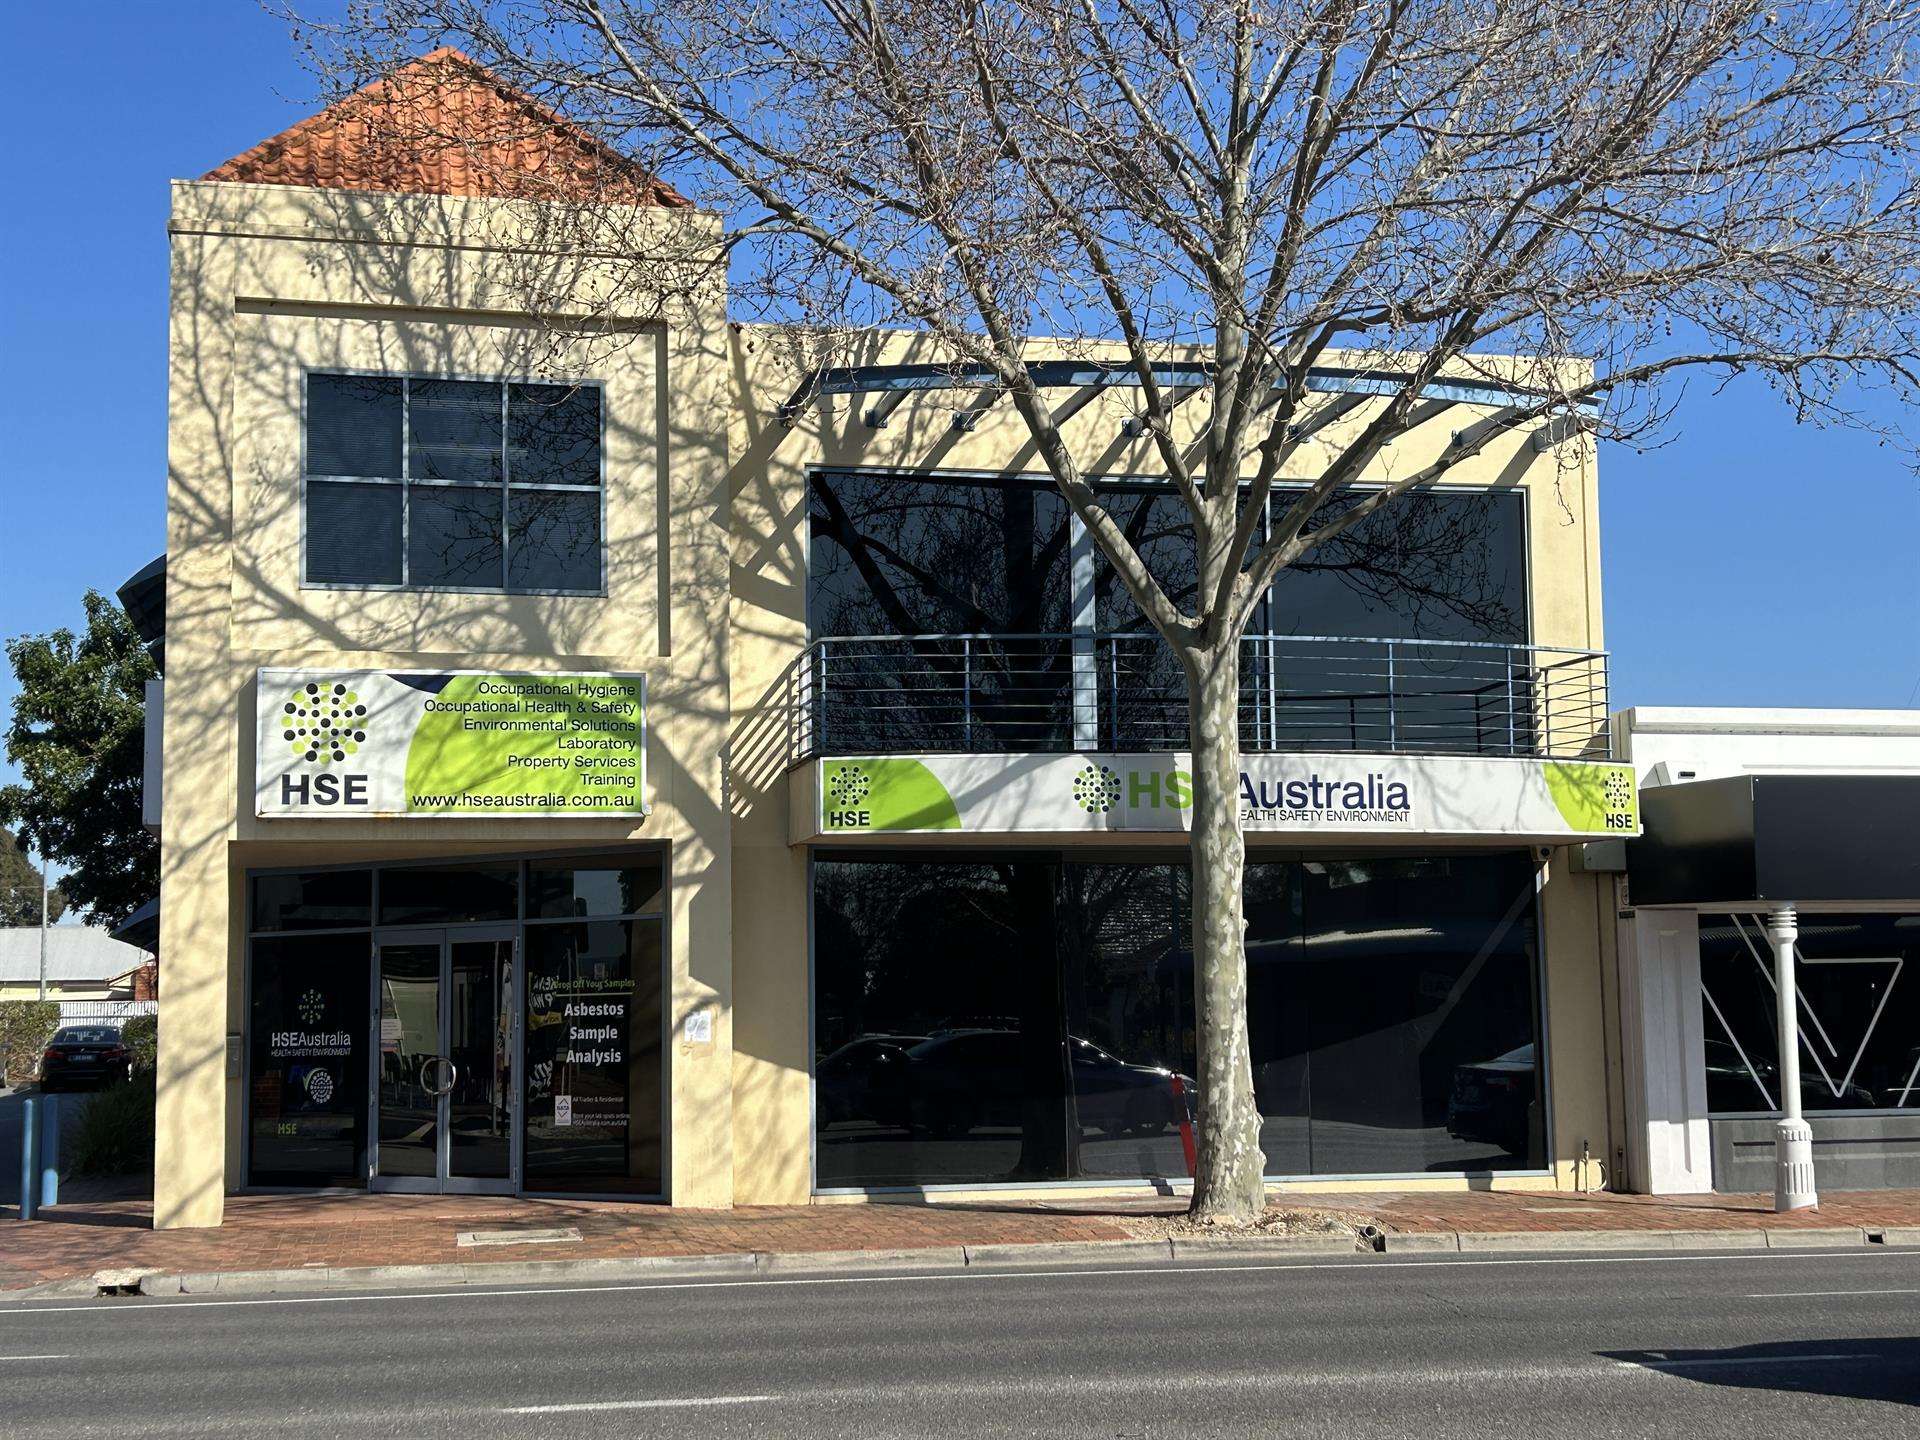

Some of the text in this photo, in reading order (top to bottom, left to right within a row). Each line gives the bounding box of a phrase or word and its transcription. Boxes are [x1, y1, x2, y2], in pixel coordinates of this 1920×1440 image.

[479, 682, 636, 698] Occupational Hygiene
[424, 699, 636, 716] Occupational Health & Safety
[464, 718, 636, 732] Environmental Solutions
[558, 737, 636, 751] Laboratory
[508, 756, 636, 770] Property Services
[580, 773, 636, 788] Training
[281, 773, 369, 806] HSE
[412, 792, 635, 807] www.hseaustralia.com.au
[829, 810, 871, 827] HSE
[1241, 809, 1411, 823] EALTH SAFETY ENVIRONMENT
[1605, 813, 1633, 829] HSE
[564, 1002, 624, 1017] Asbestos
[271, 1030, 352, 1048] HSEAustralia
[569, 1025, 618, 1043] Sample
[565, 1048, 622, 1067] Analysis
[278, 1122, 298, 1135] HSE
